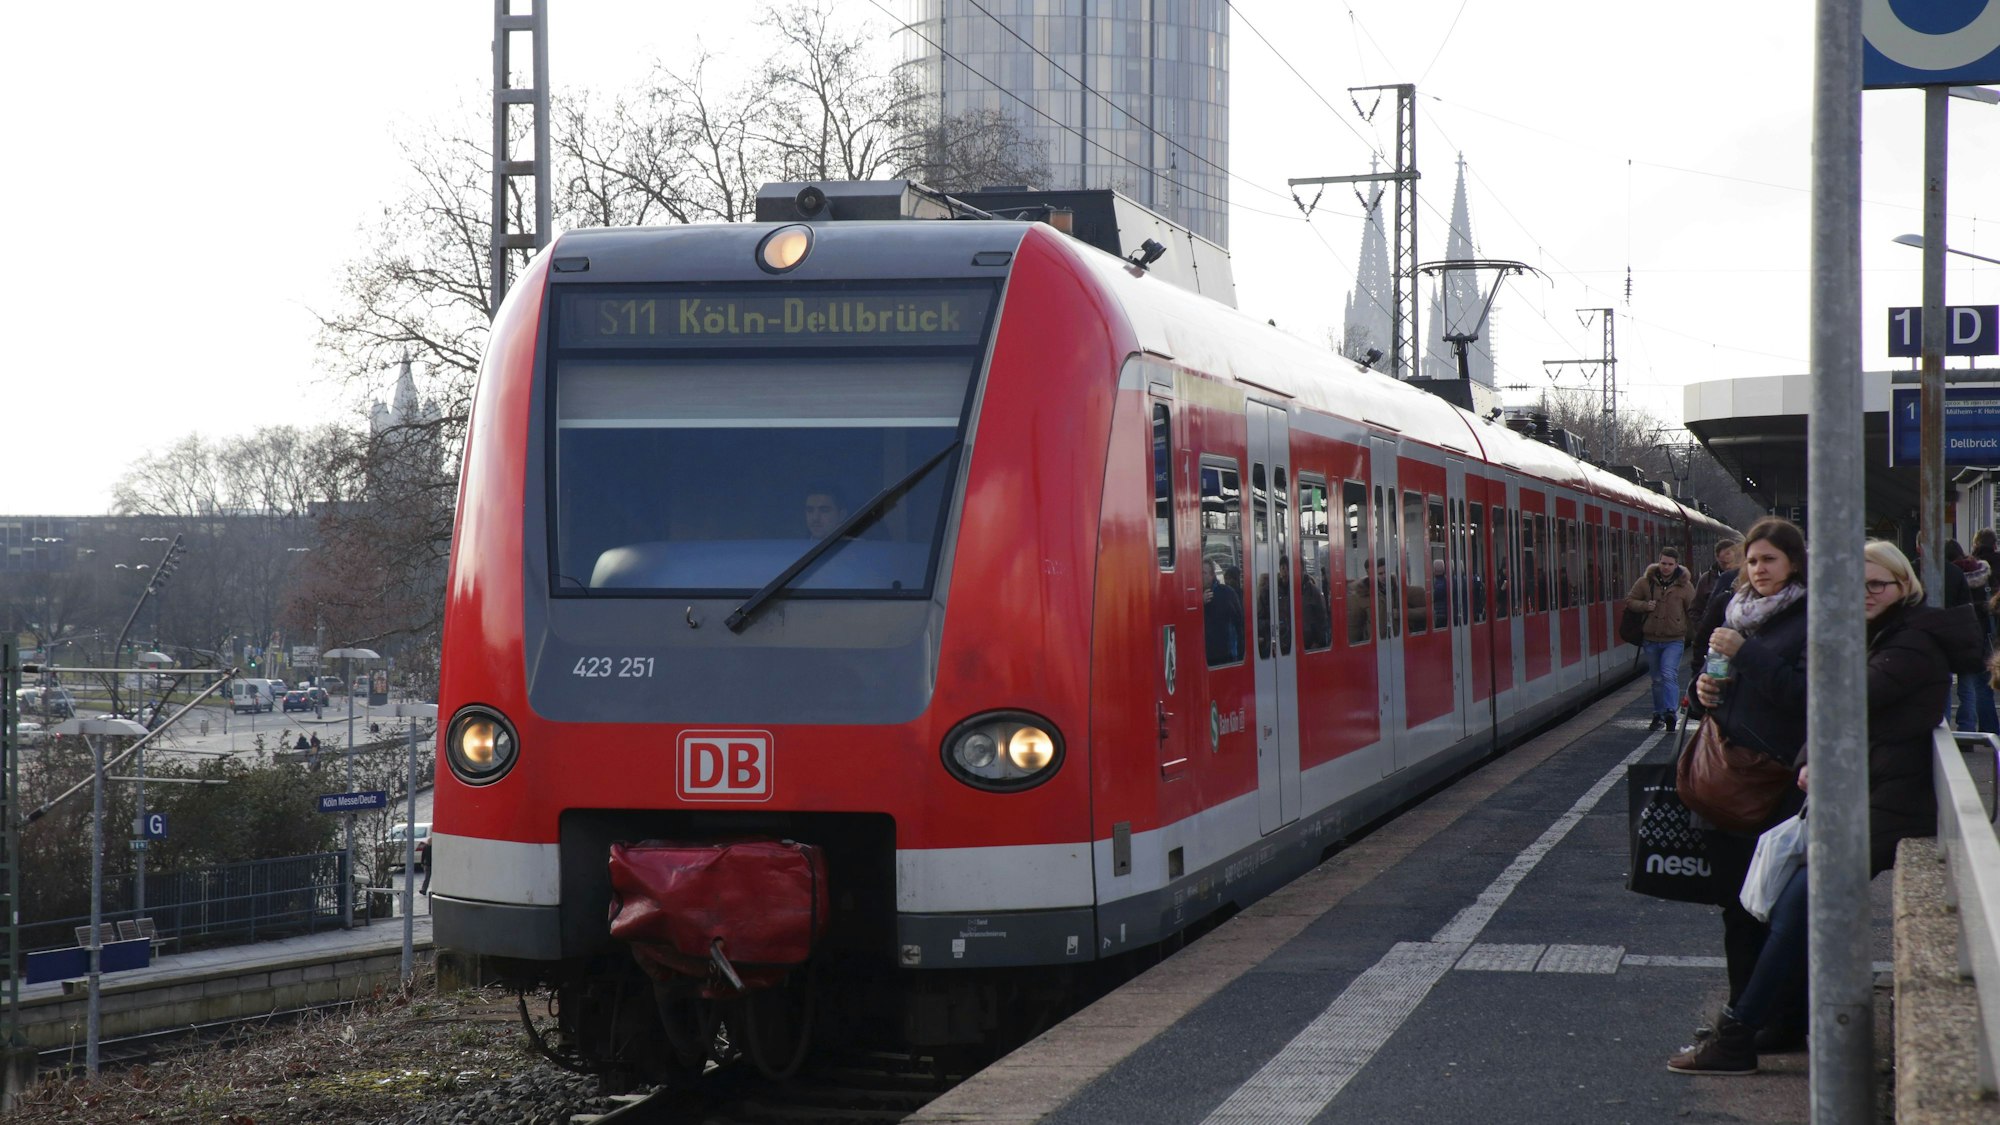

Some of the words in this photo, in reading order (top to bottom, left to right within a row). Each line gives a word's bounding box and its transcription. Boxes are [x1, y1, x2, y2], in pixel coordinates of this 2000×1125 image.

[600, 299, 656, 335] S11
[679, 297, 961, 335] Köln-Dellbrück
[1895, 309, 1910, 345] 1
[1953, 308, 1982, 344] D
[1906, 402, 1914, 420] 1
[1950, 438, 1998, 448] Dellbrück
[572, 656, 613, 678] 423
[618, 656, 655, 678] 251
[687, 740, 763, 791] DB
[323, 797, 338, 808] Köln
[338, 794, 377, 806] Messe/Deutz
[150, 814, 163, 835] G
